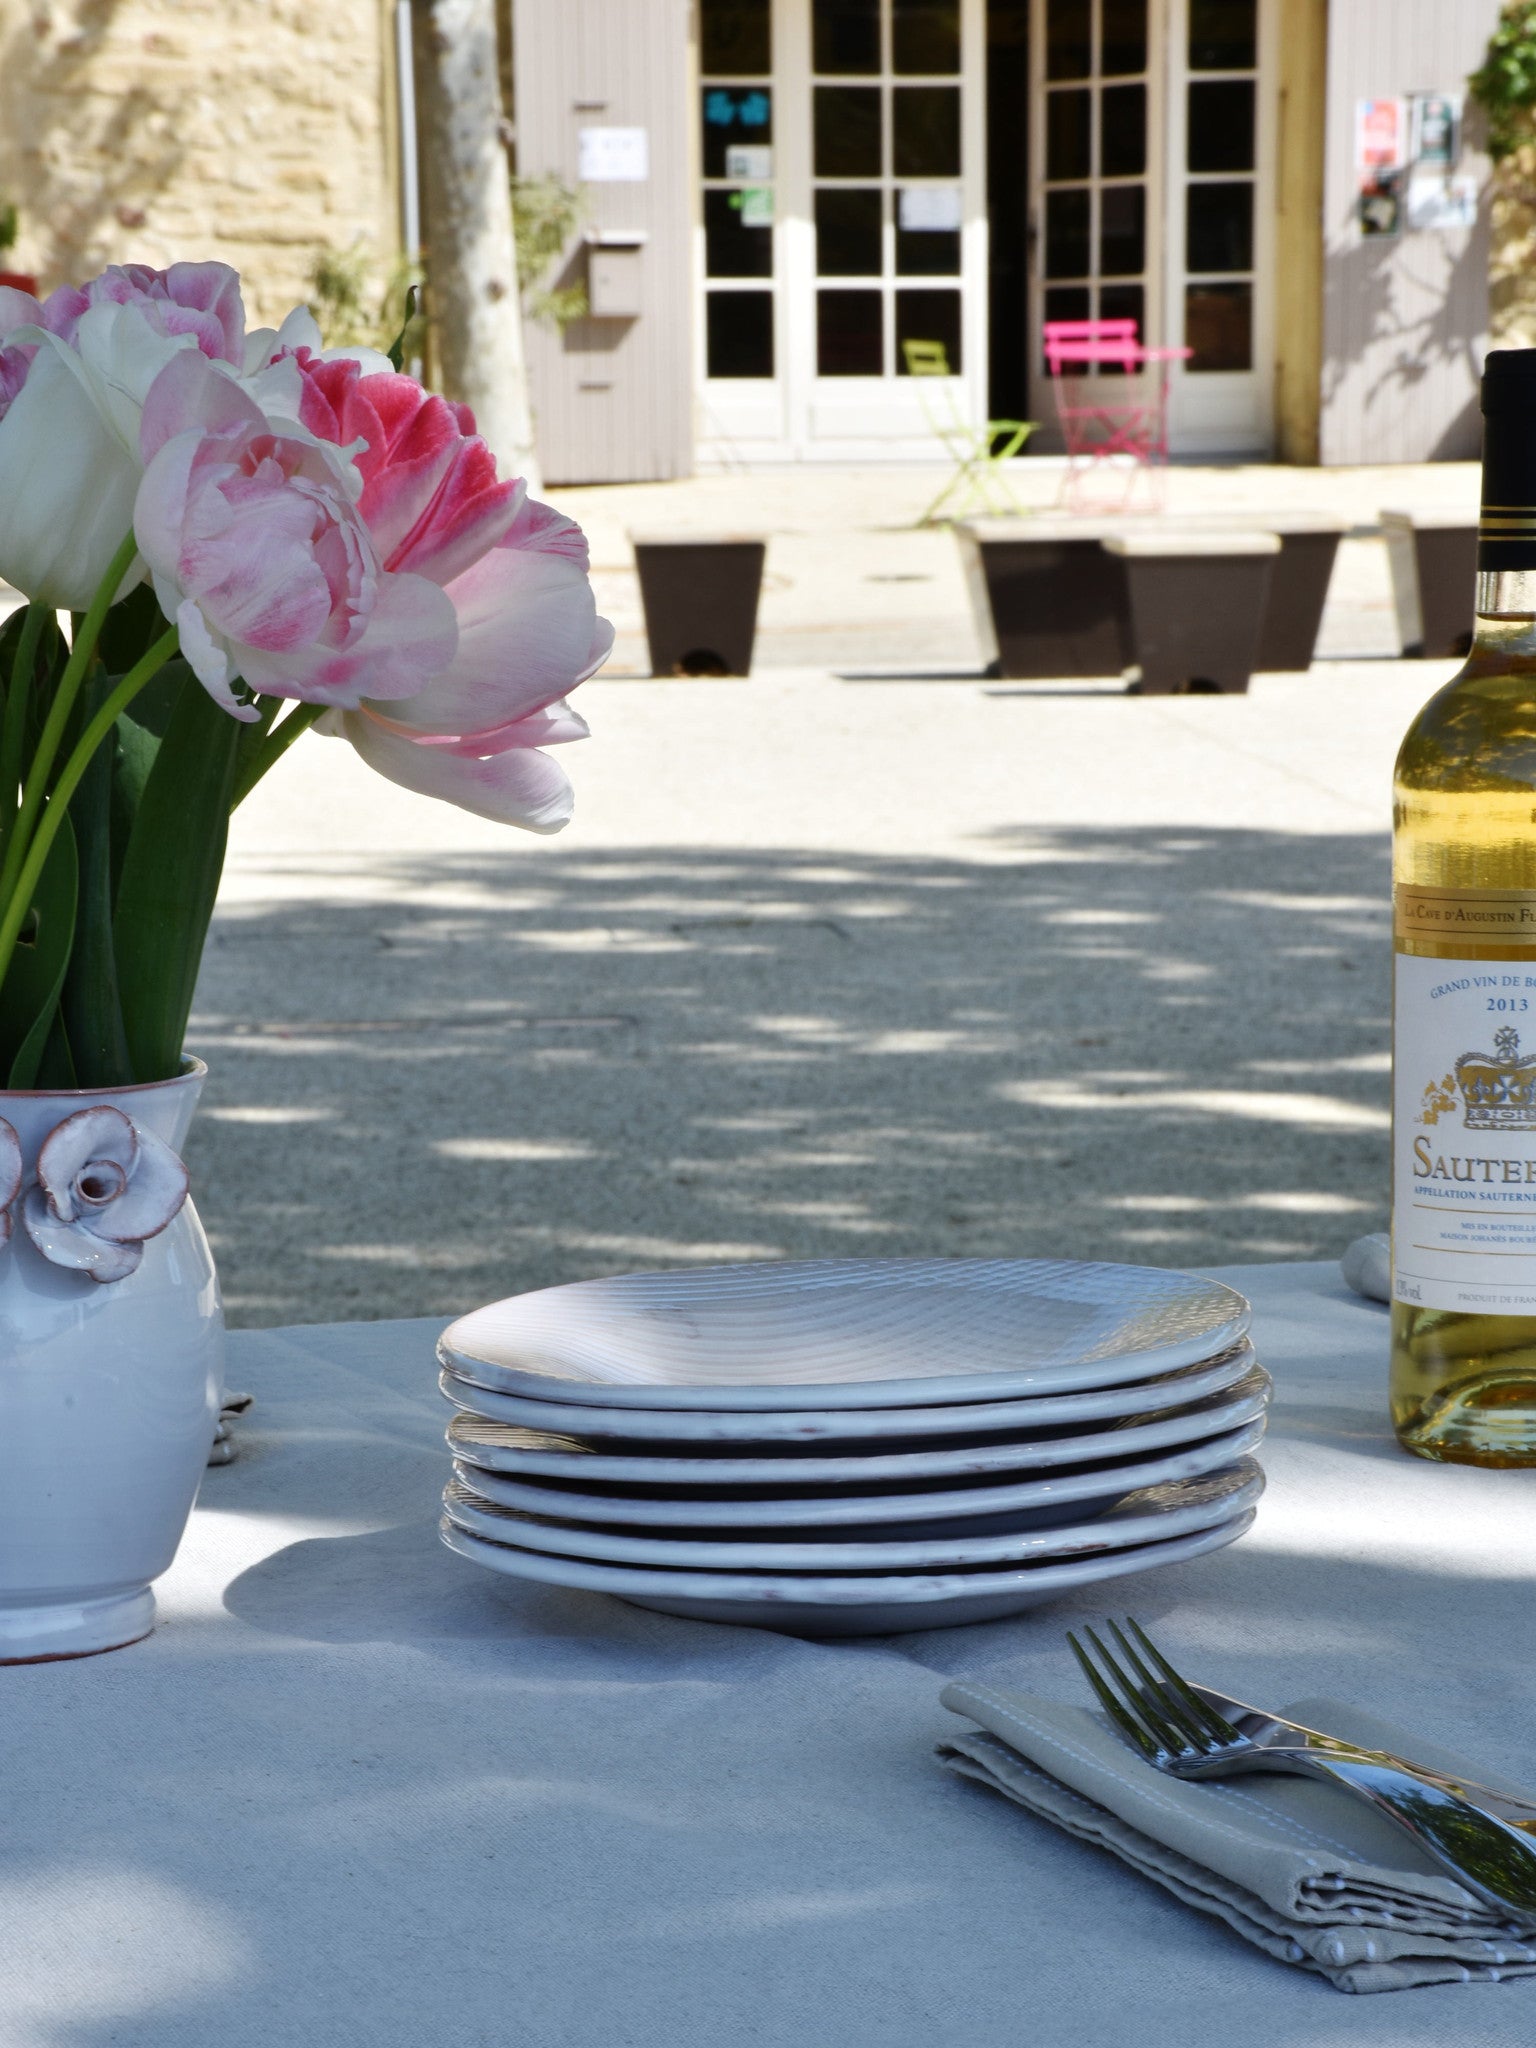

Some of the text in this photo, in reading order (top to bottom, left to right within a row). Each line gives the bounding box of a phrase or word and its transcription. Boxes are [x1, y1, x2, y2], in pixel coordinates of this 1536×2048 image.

[1416, 904, 1441, 920] CAVE
[1445, 908, 1516, 923] D'AUGUSTIN
[1430, 979, 1470, 999] GRAND
[1473, 976, 1498, 988] VIN
[1502, 976, 1521, 987] DE
[1486, 998, 1529, 1012] 2013
[1414, 1186, 1477, 1201] APPELLATION
[1458, 1293, 1497, 1304] PRODUIT
[1499, 1295, 1512, 1304] DE
